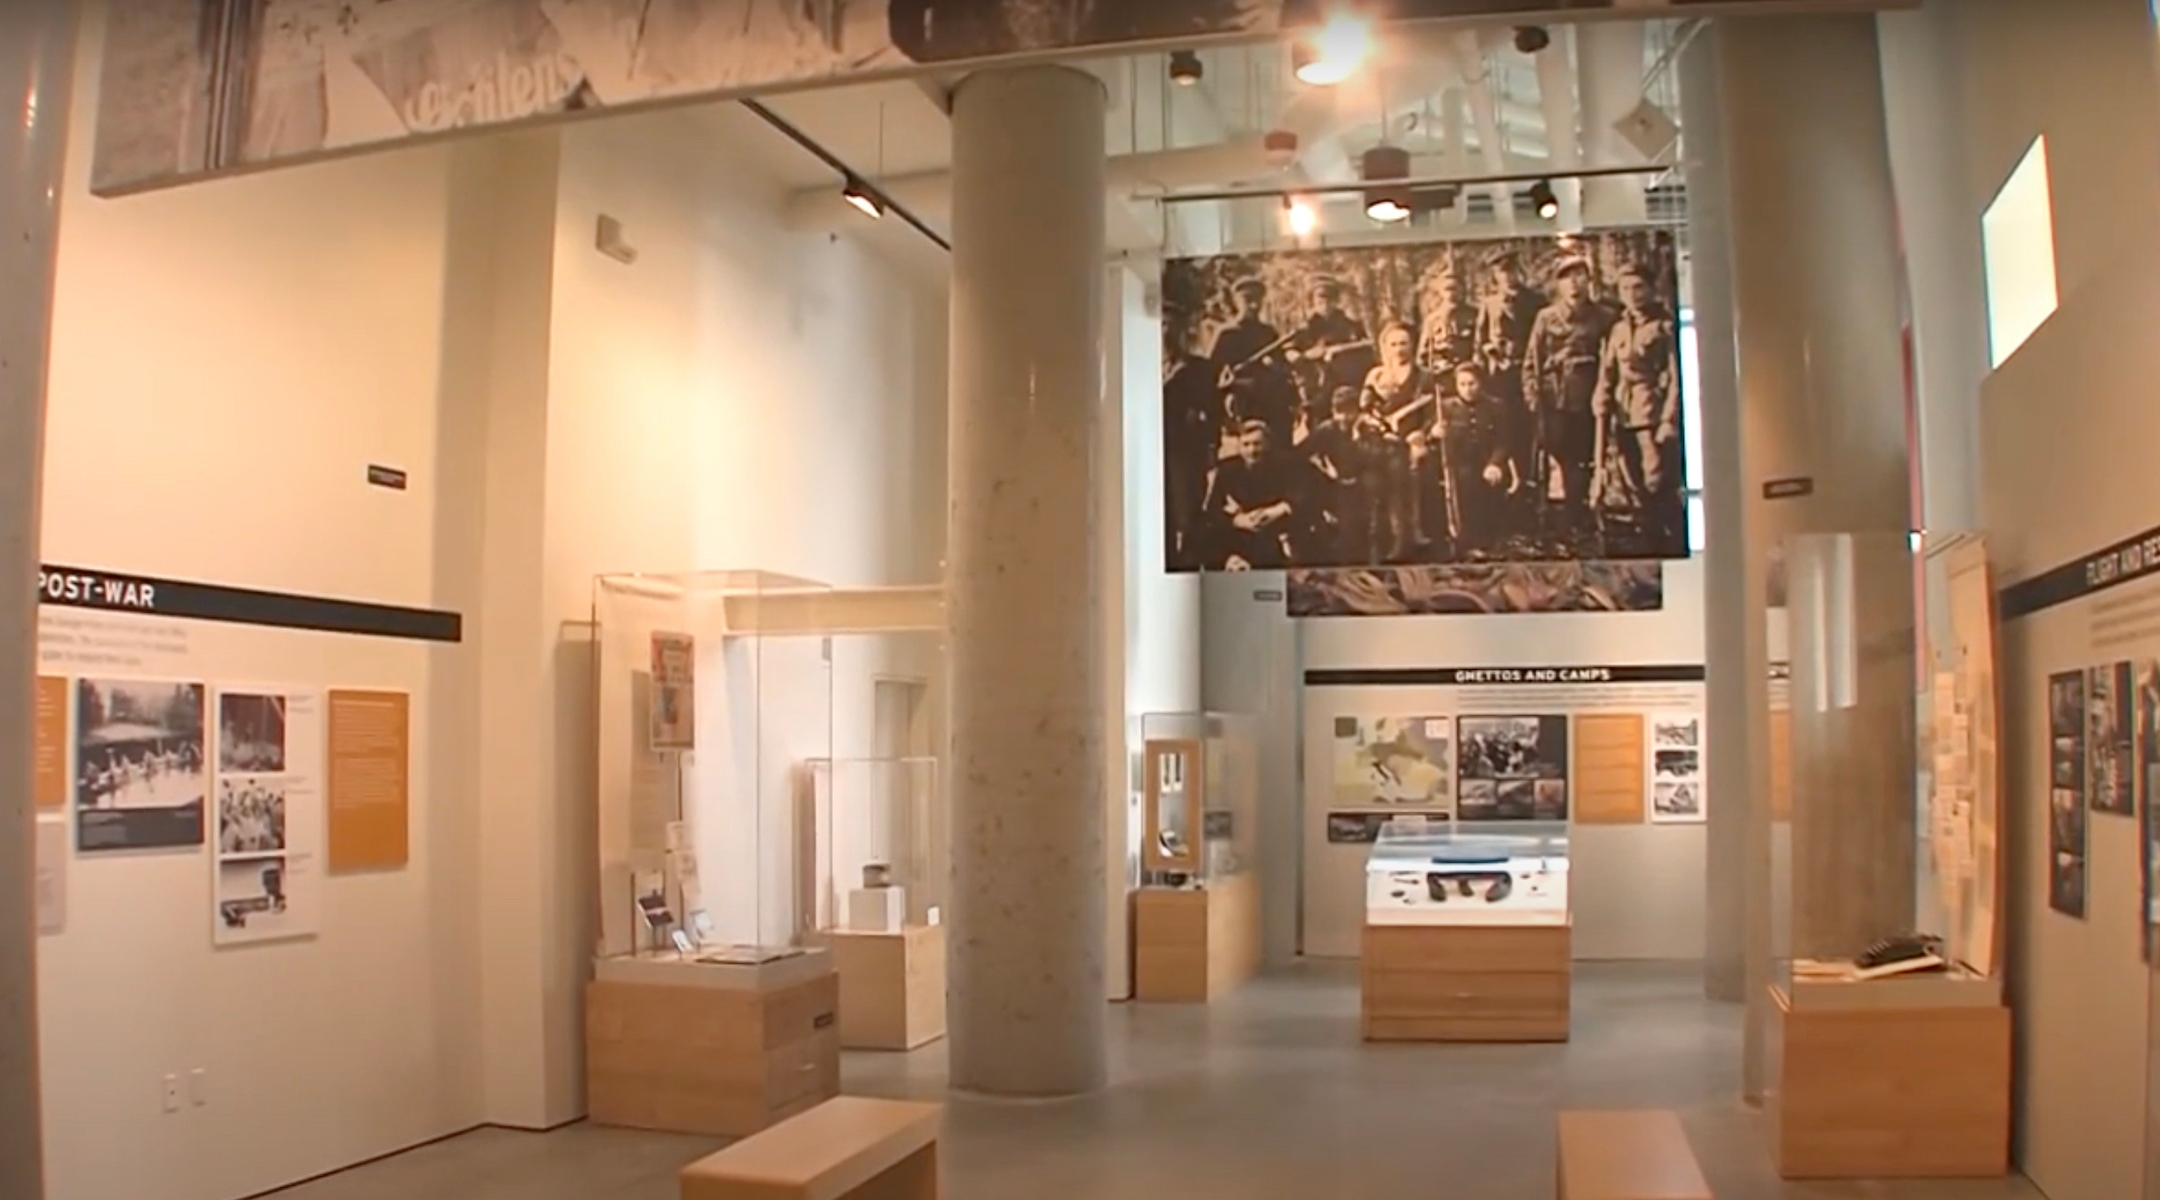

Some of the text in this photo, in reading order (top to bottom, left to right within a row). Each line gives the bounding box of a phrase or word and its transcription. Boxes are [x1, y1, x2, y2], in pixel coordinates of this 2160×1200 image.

[2121, 544, 2142, 575] AND
[38, 571, 155, 608] POST-WAR
[1455, 668, 1611, 682] GHETTOS AND CAMPS
